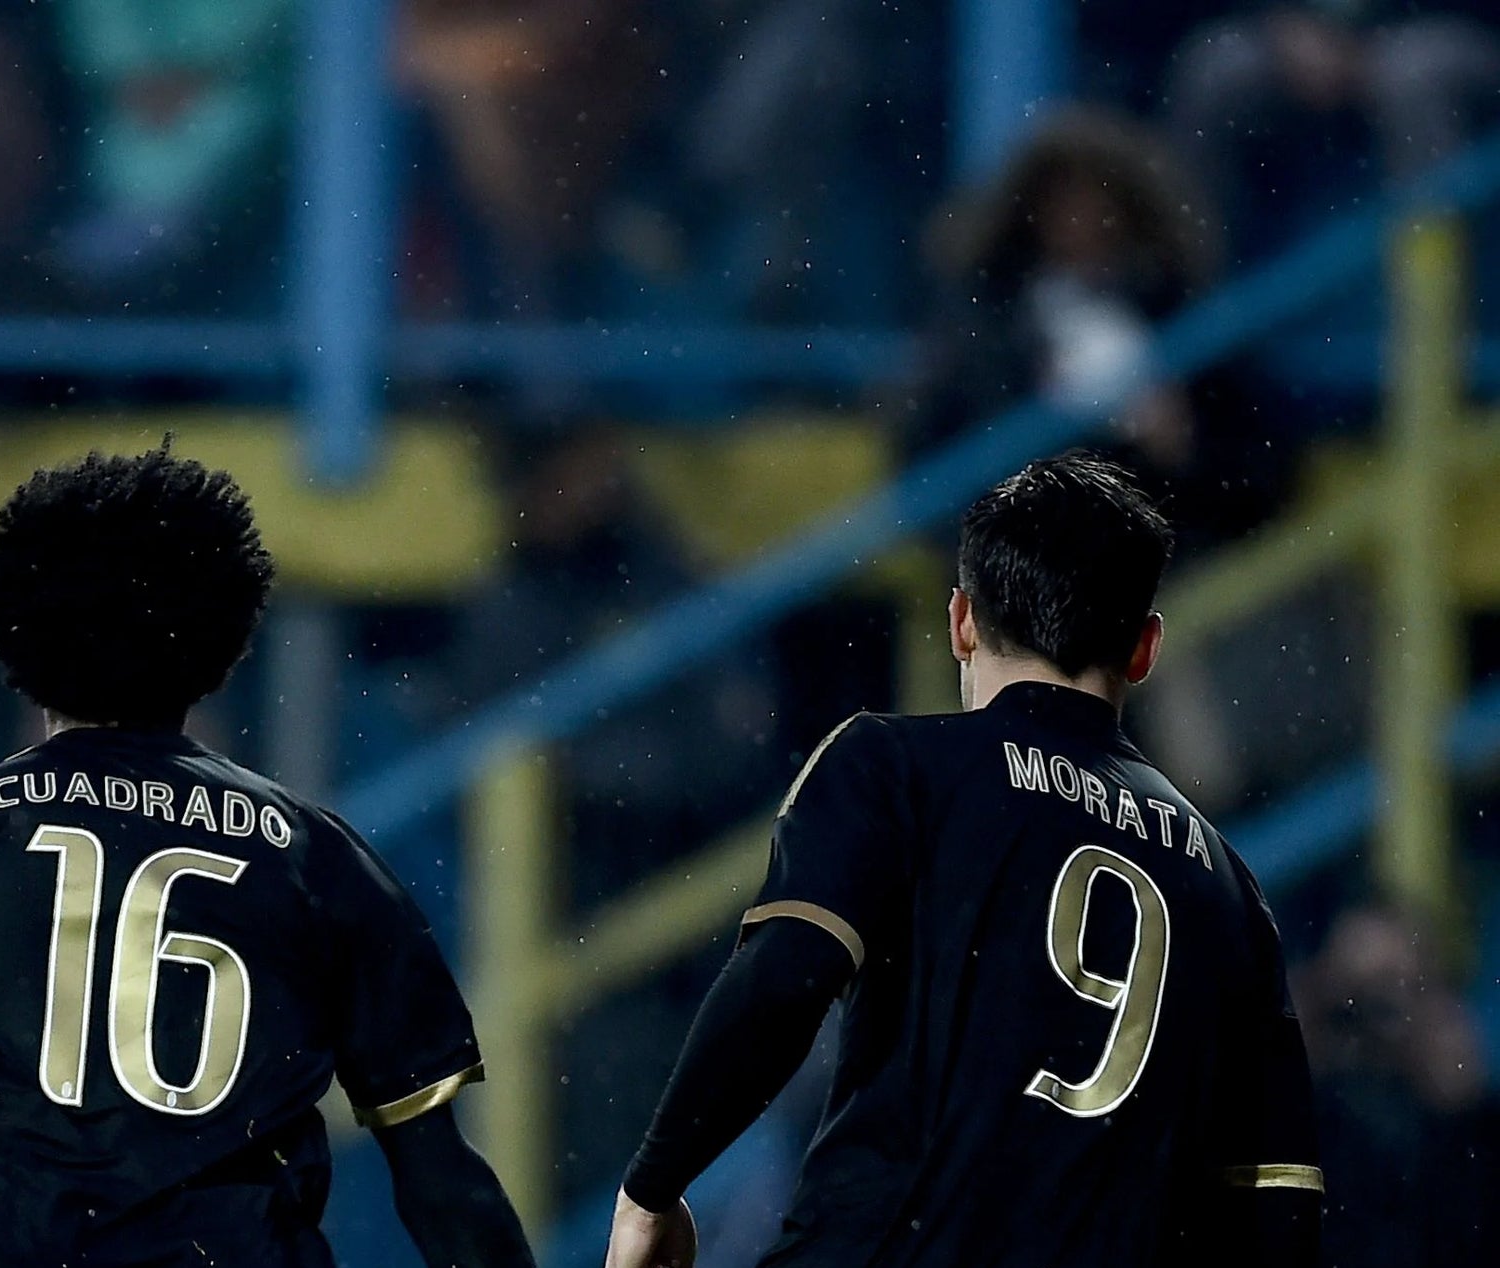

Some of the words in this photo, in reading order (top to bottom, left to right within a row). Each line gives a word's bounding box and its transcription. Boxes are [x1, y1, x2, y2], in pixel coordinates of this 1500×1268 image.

[1004, 742, 1213, 871] MORATA
[25, 823, 251, 1116] 16
[1023, 844, 1171, 1119] 9
